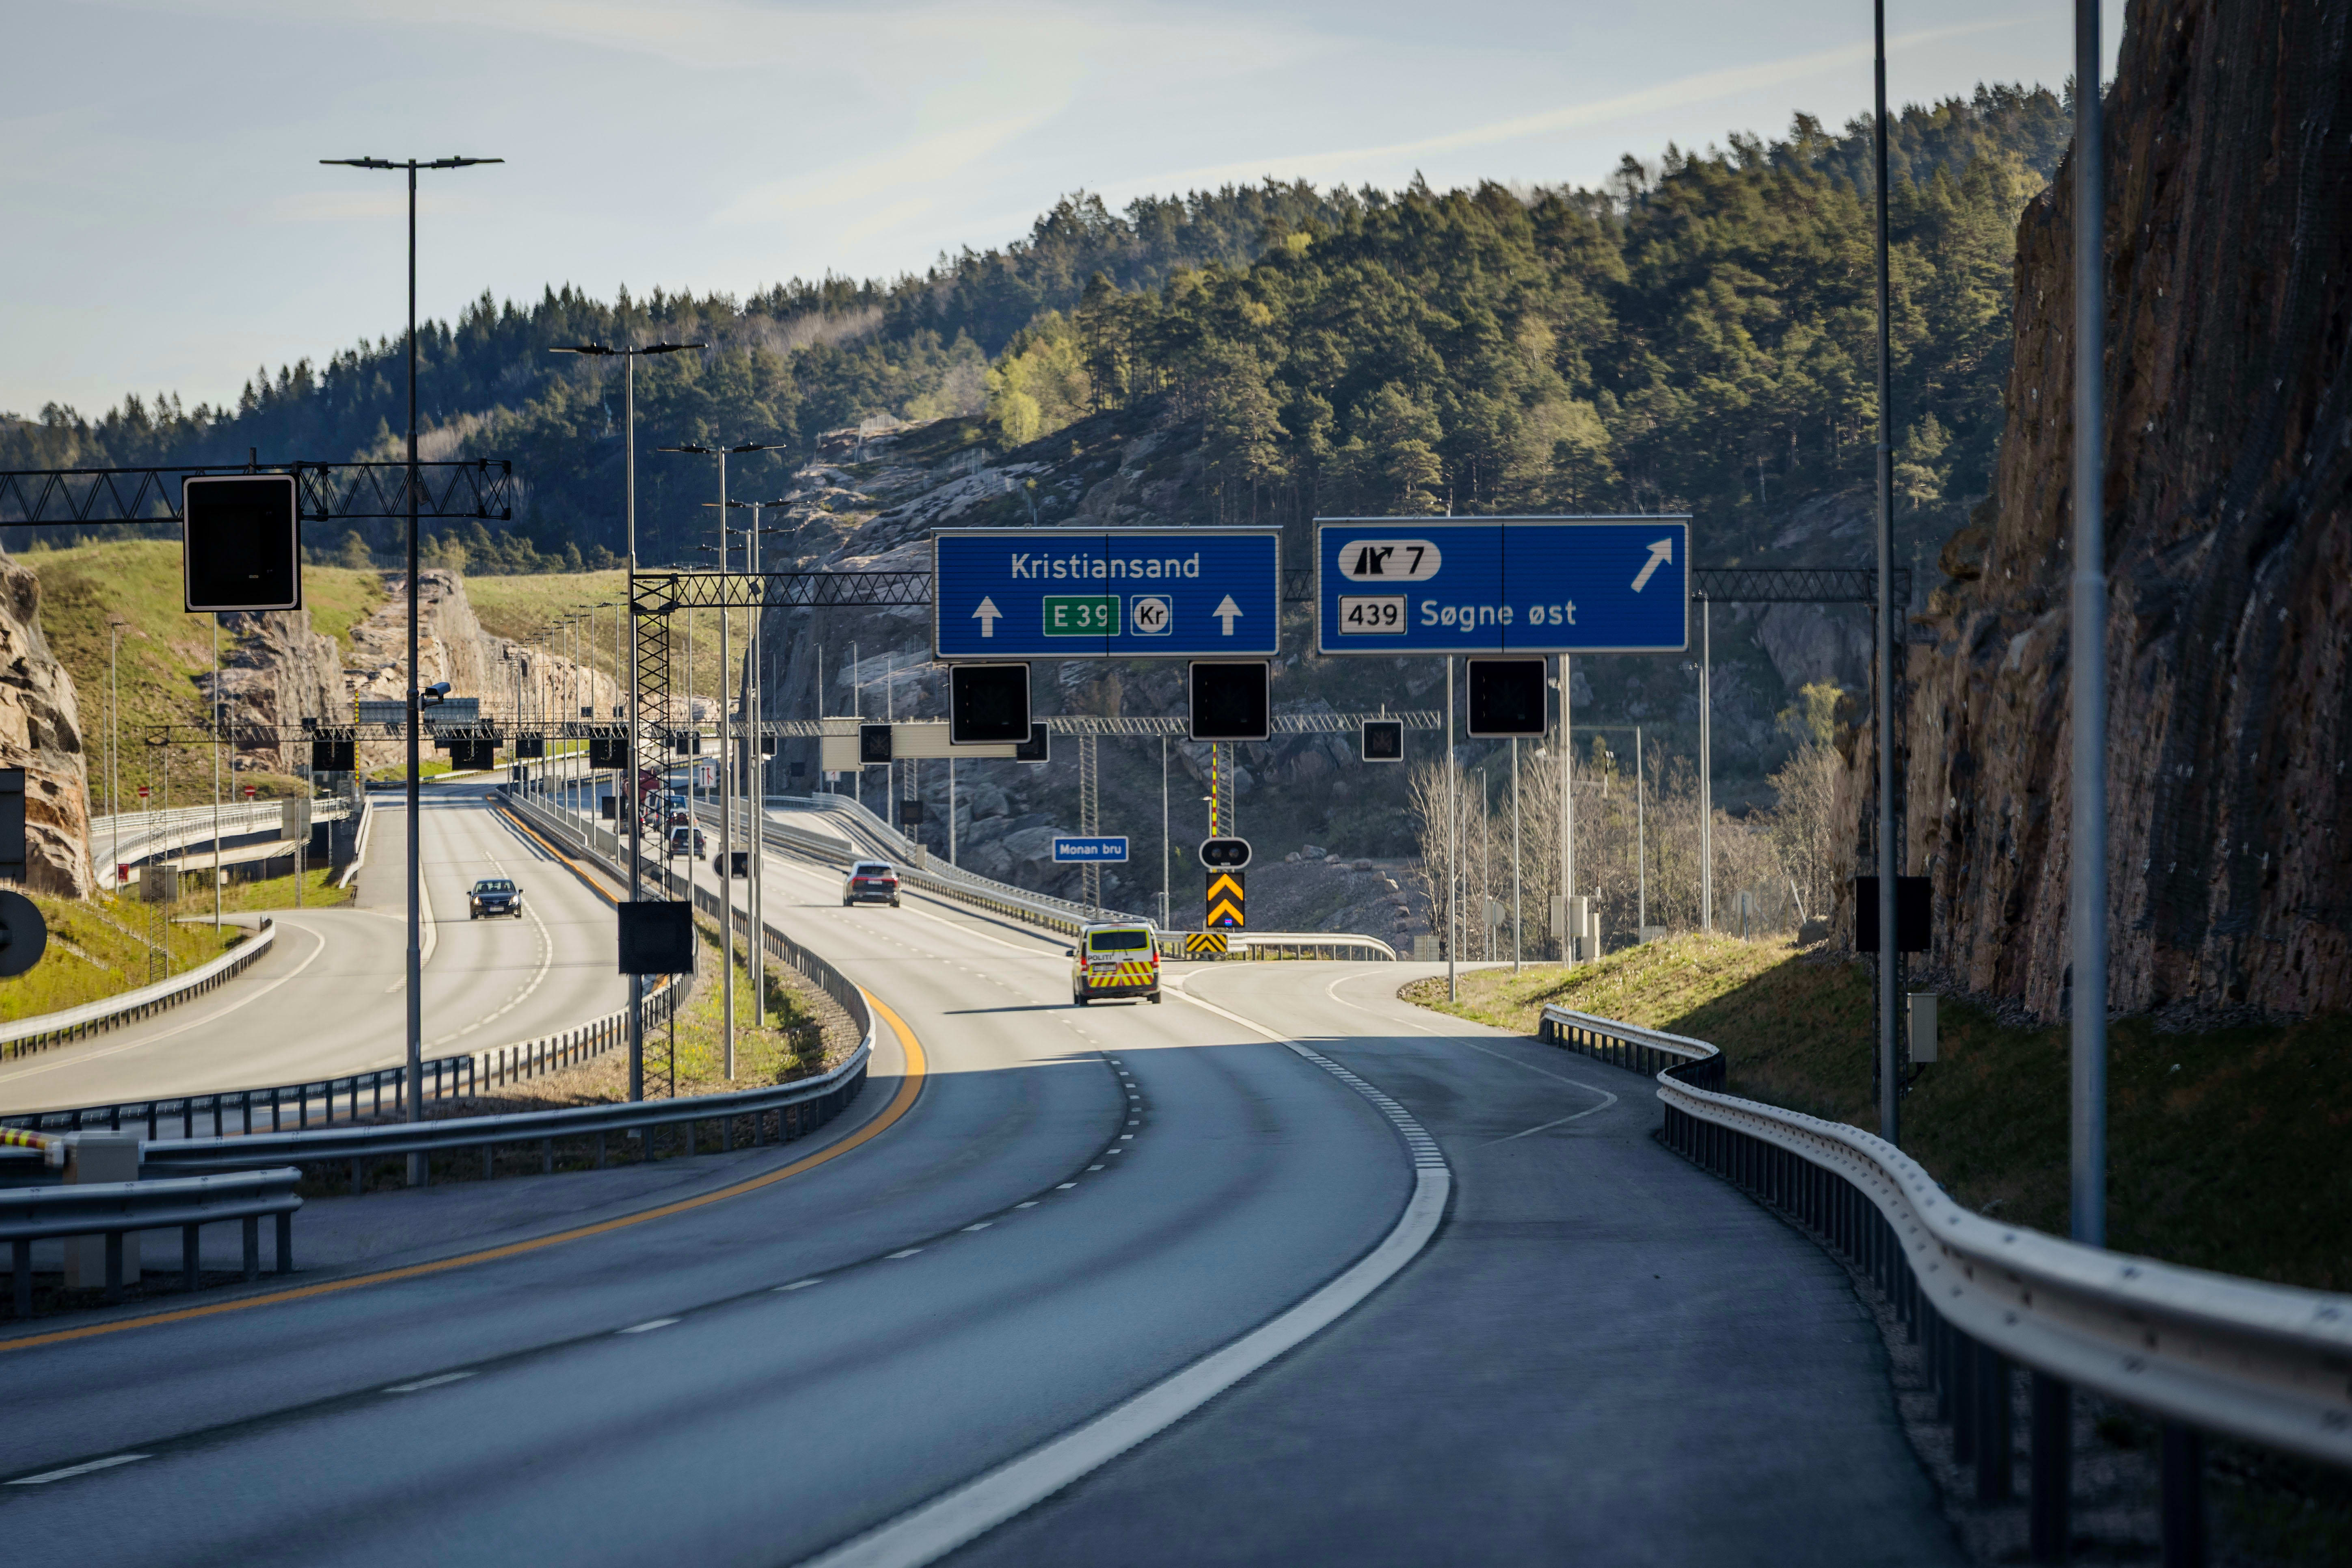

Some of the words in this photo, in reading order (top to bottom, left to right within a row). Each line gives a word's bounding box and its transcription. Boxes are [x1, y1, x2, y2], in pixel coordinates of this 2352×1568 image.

[1012, 553, 1199, 579] Kristiansand
[1406, 546, 1424, 574] 7
[1054, 605, 1068, 626] E
[1077, 605, 1108, 627] 39
[1140, 606, 1164, 625] Kr
[1348, 604, 1397, 626] 439
[1421, 600, 1513, 632] Søgne
[1529, 600, 1577, 625] øst
[1060, 844, 1098, 855] Monan
[1103, 843, 1122, 854] bru
